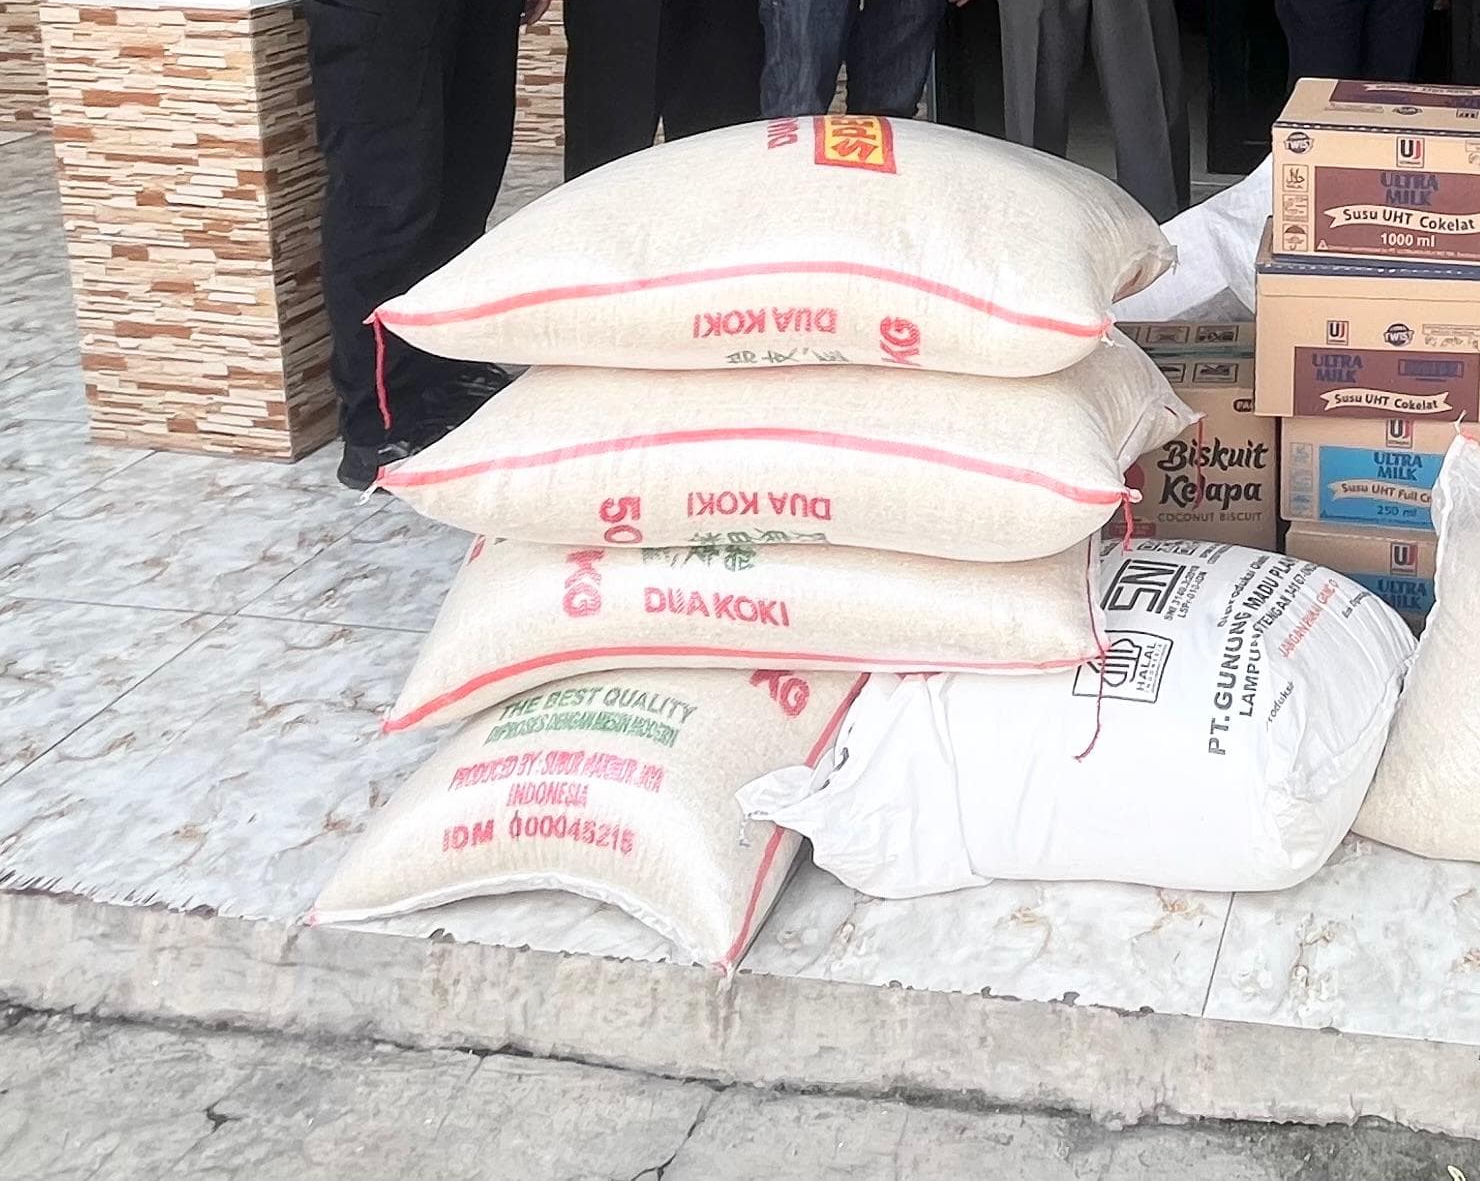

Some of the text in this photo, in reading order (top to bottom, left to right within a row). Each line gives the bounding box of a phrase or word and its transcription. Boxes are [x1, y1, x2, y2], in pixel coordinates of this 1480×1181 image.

[1380, 172, 1438, 191] ULTRA
[1385, 189, 1433, 207] MILK
[1343, 208, 1475, 231] Susu UHT Cokelat
[1380, 232, 1435, 247] 1000 ml
[693, 307, 837, 339] DUA KOKI
[879, 316, 921, 366] KG
[1312, 354, 1363, 369] ULTRA
[1316, 369, 1357, 383] MILK
[1335, 393, 1438, 411] Susu UHT Cokelat
[1157, 438, 1269, 471] Biskuit
[1373, 451, 1423, 467] ULTRA
[1377, 466, 1418, 481] MILK
[1159, 474, 1263, 510] Kelapa
[1341, 483, 1368, 493] Susu
[1372, 484, 1395, 497] UHT
[1398, 489, 1418, 501] Full
[688, 491, 832, 521] DUA KOKI
[1158, 512, 1262, 522] COCONUT BISCUIT
[1376, 505, 1417, 517] 250 ml
[599, 496, 643, 544] 50
[562, 550, 605, 618] KG
[1104, 560, 1185, 614] SNI
[1378, 579, 1427, 597] ULTRA
[643, 587, 790, 626] DUA KOKI
[1136, 642, 1157, 691] HALAL
[1208, 571, 1279, 756] PT. GUNUNG MADU
[500, 687, 698, 723] THE BEST QUALITY
[506, 781, 589, 807] INDONESIA
[442, 818, 494, 852] IDM
